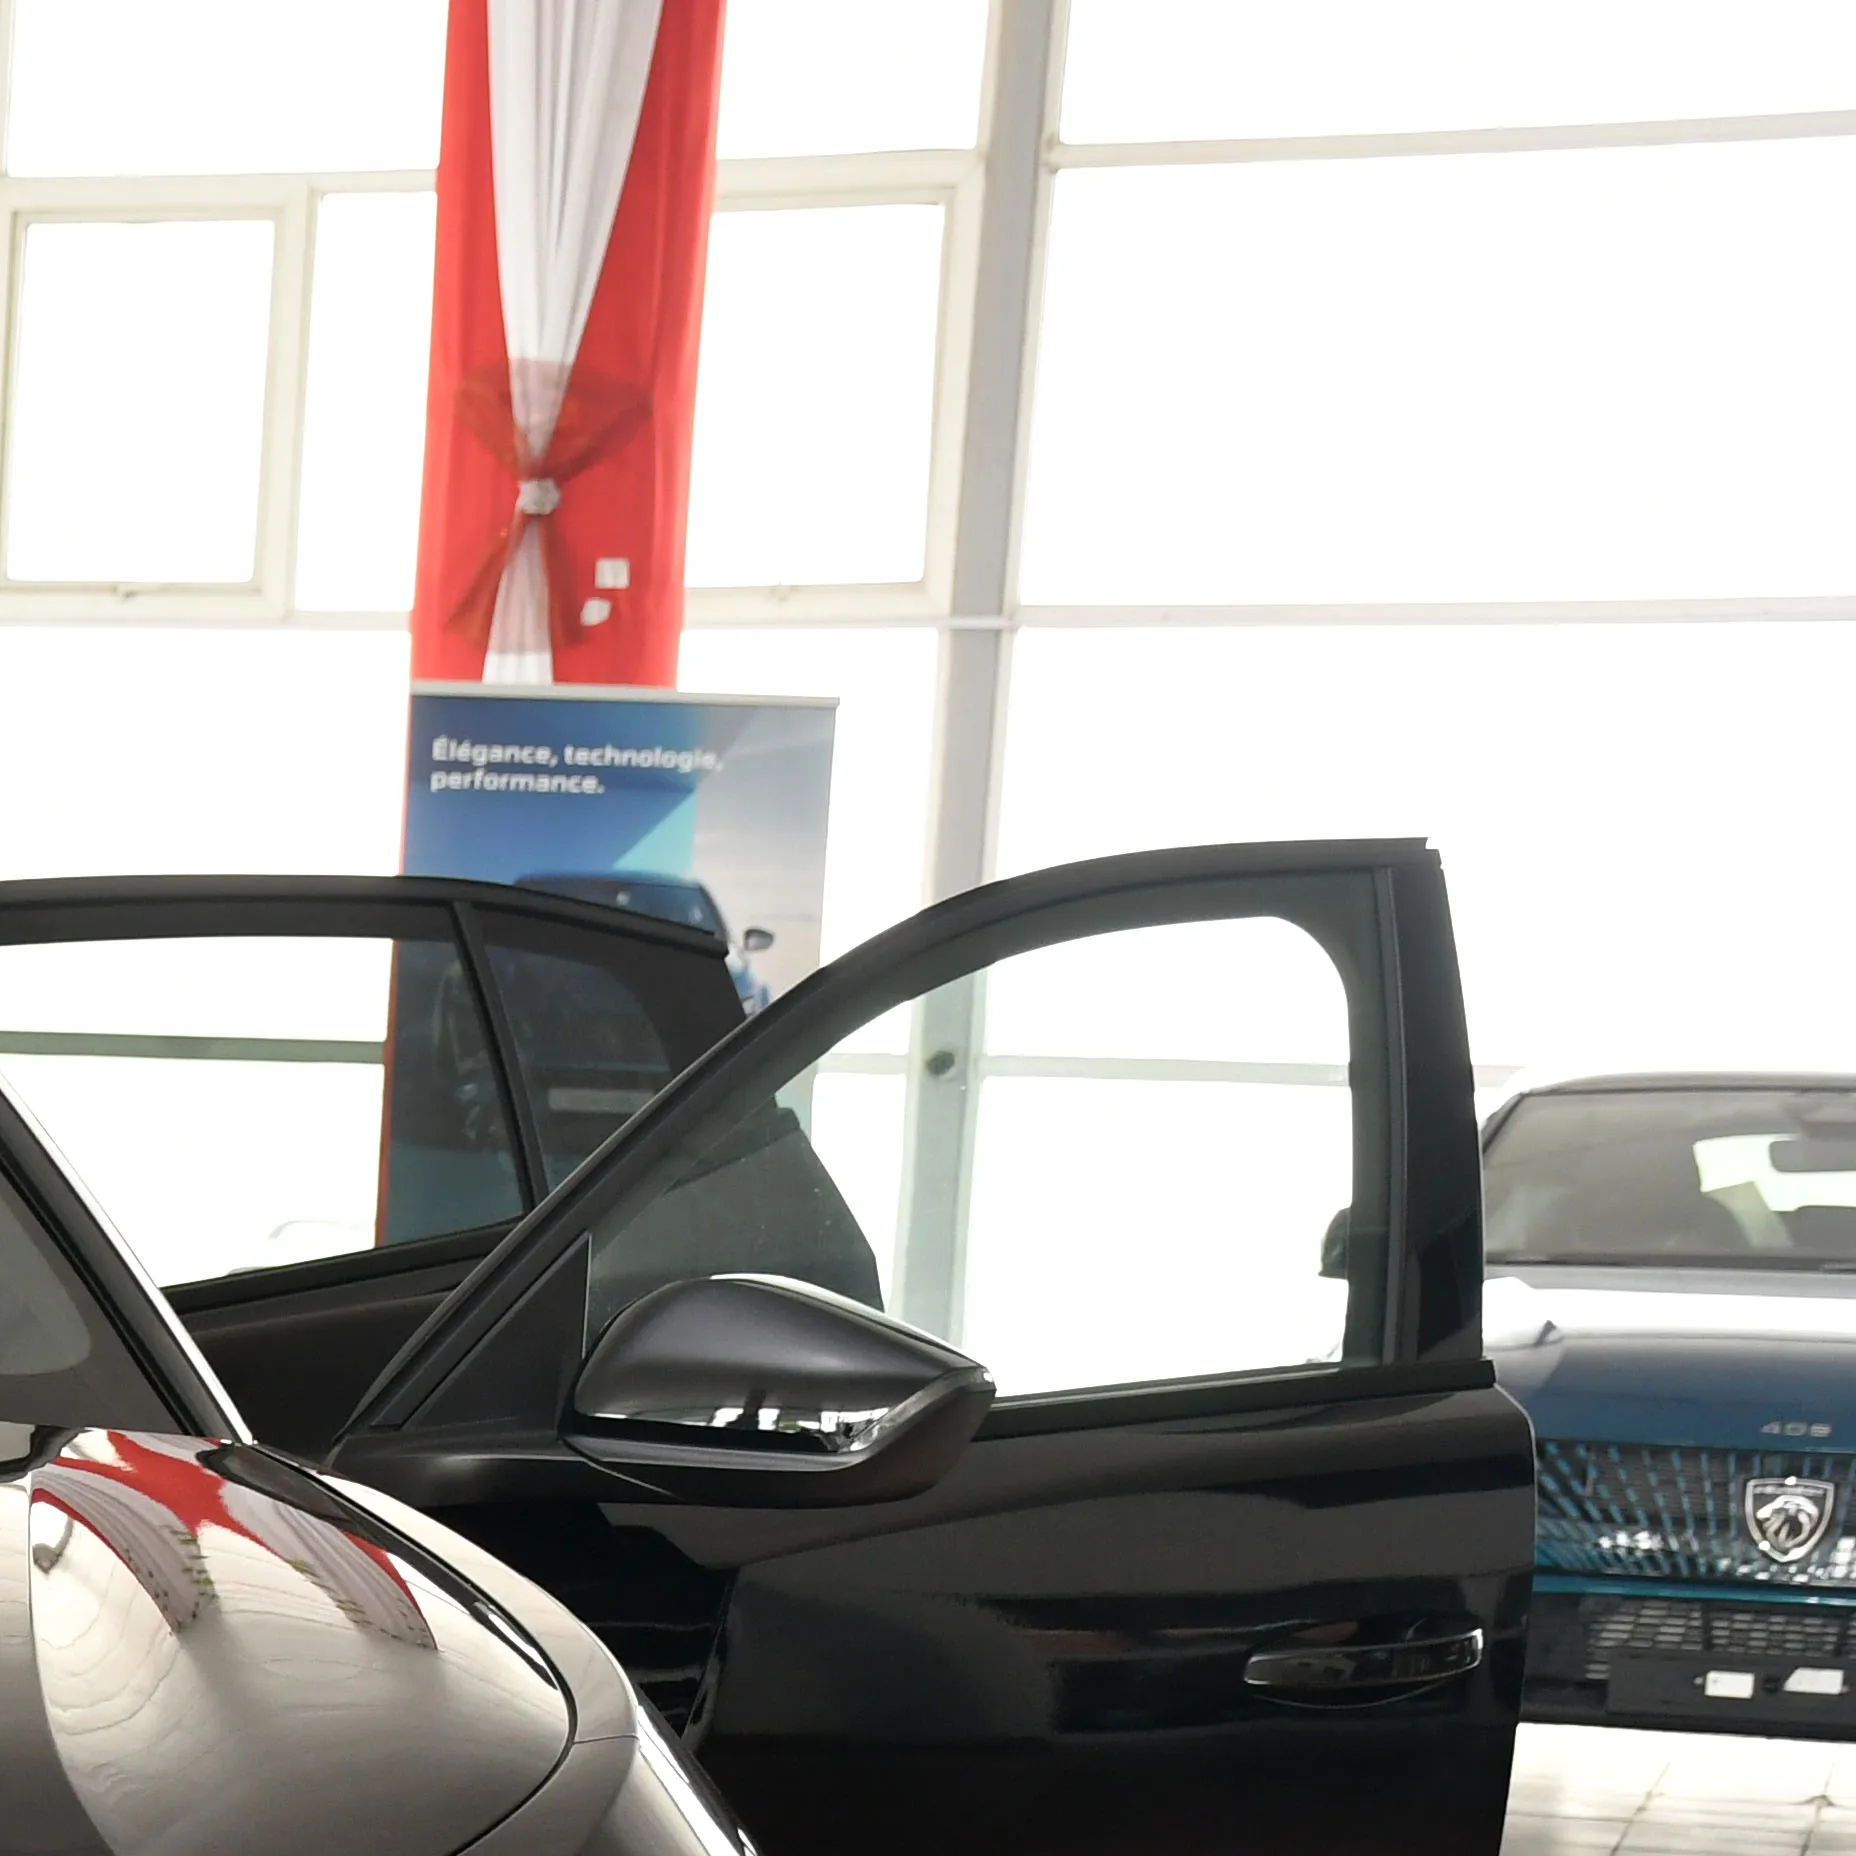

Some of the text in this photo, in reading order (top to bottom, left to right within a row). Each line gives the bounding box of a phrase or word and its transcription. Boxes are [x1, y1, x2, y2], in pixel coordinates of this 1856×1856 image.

[432, 735, 724, 773] Élégance, technologie,
[430, 768, 606, 794] performance.
